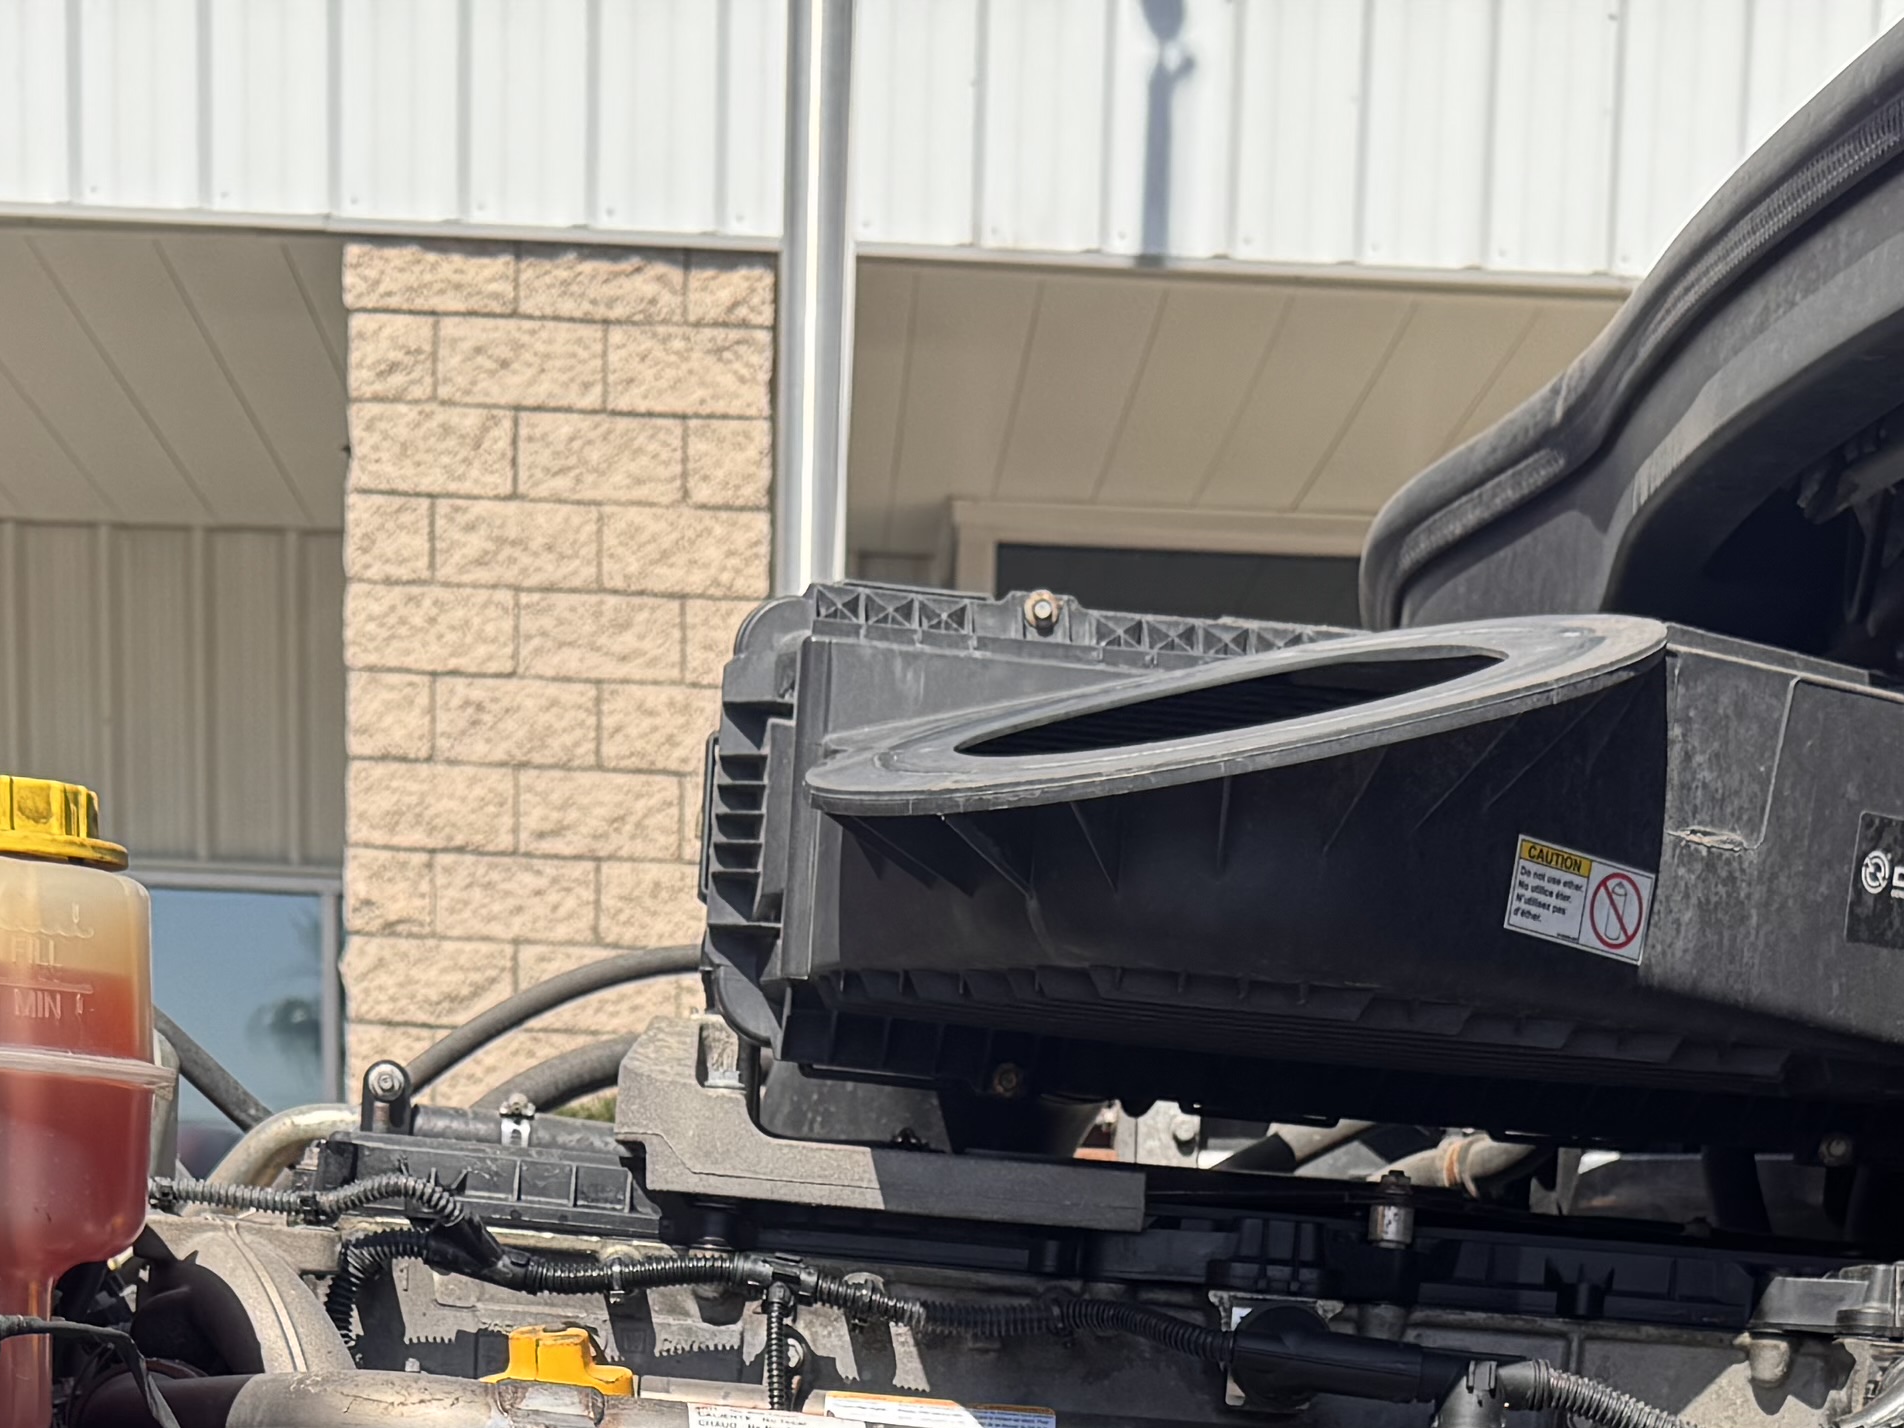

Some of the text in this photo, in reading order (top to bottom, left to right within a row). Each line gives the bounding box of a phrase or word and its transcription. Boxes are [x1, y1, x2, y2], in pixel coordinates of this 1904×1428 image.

[1528, 846, 1582, 873] CAUTION
[1520, 865, 1531, 876] Do
[1533, 870, 1545, 880] not
[1547, 874, 1562, 884] use
[1552, 904, 1566, 915] pas
[11, 936, 63, 967] FILL
[13, 988, 62, 1019] MIN
